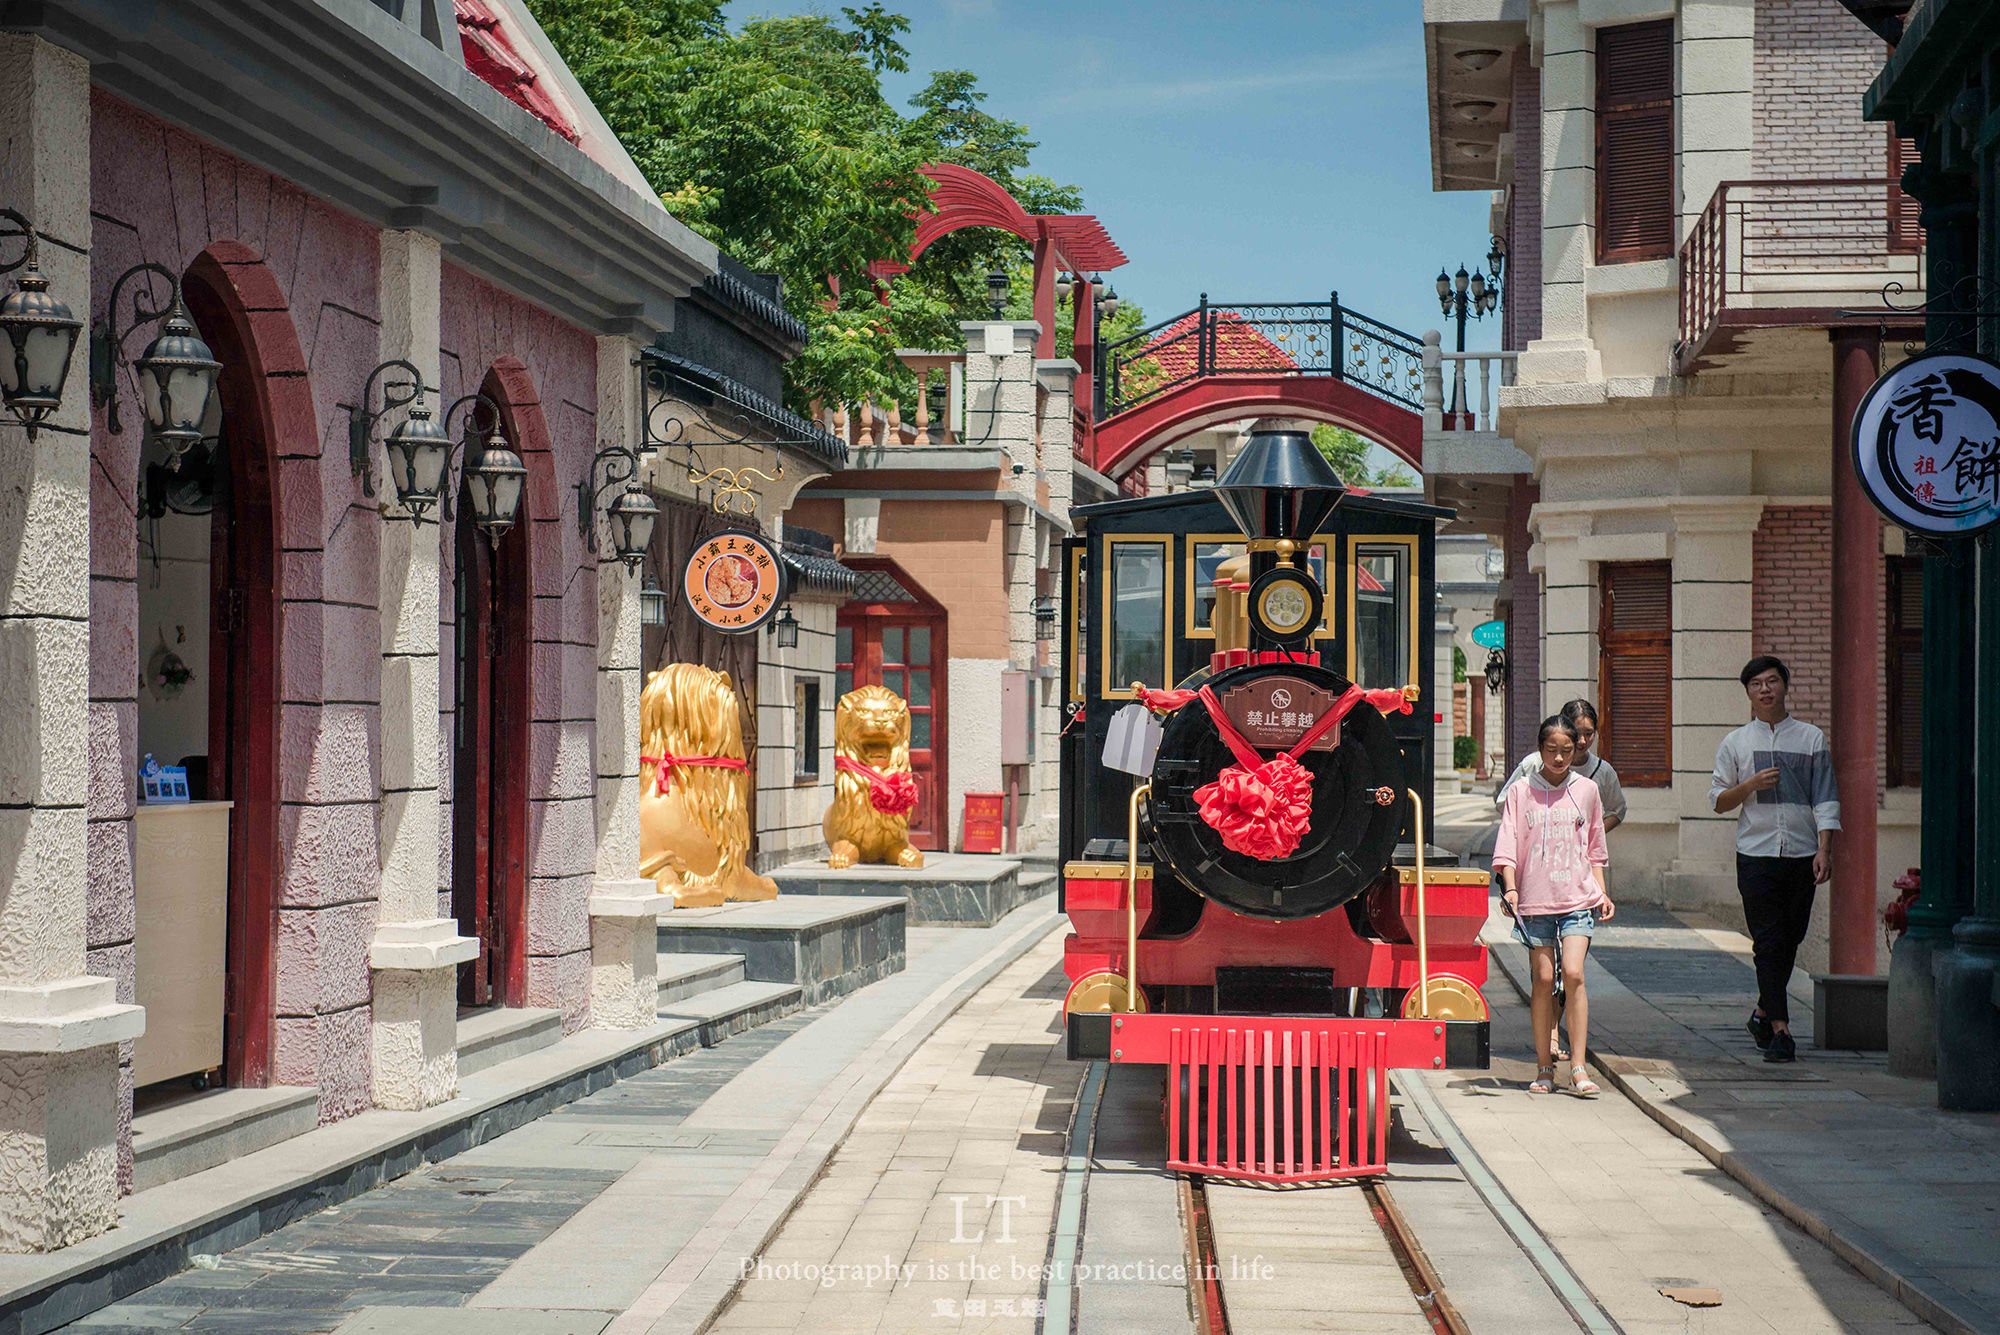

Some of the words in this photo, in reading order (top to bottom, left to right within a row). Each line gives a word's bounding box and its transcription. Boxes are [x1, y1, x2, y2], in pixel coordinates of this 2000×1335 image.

[1912, 455, 1938, 505] 祖傳
[695, 538, 771, 569] 小霸王鸡排
[719, 614, 746, 624] 小吃
[1246, 710, 1314, 728] 禁止攀越
[1530, 840, 1583, 872] PARIS
